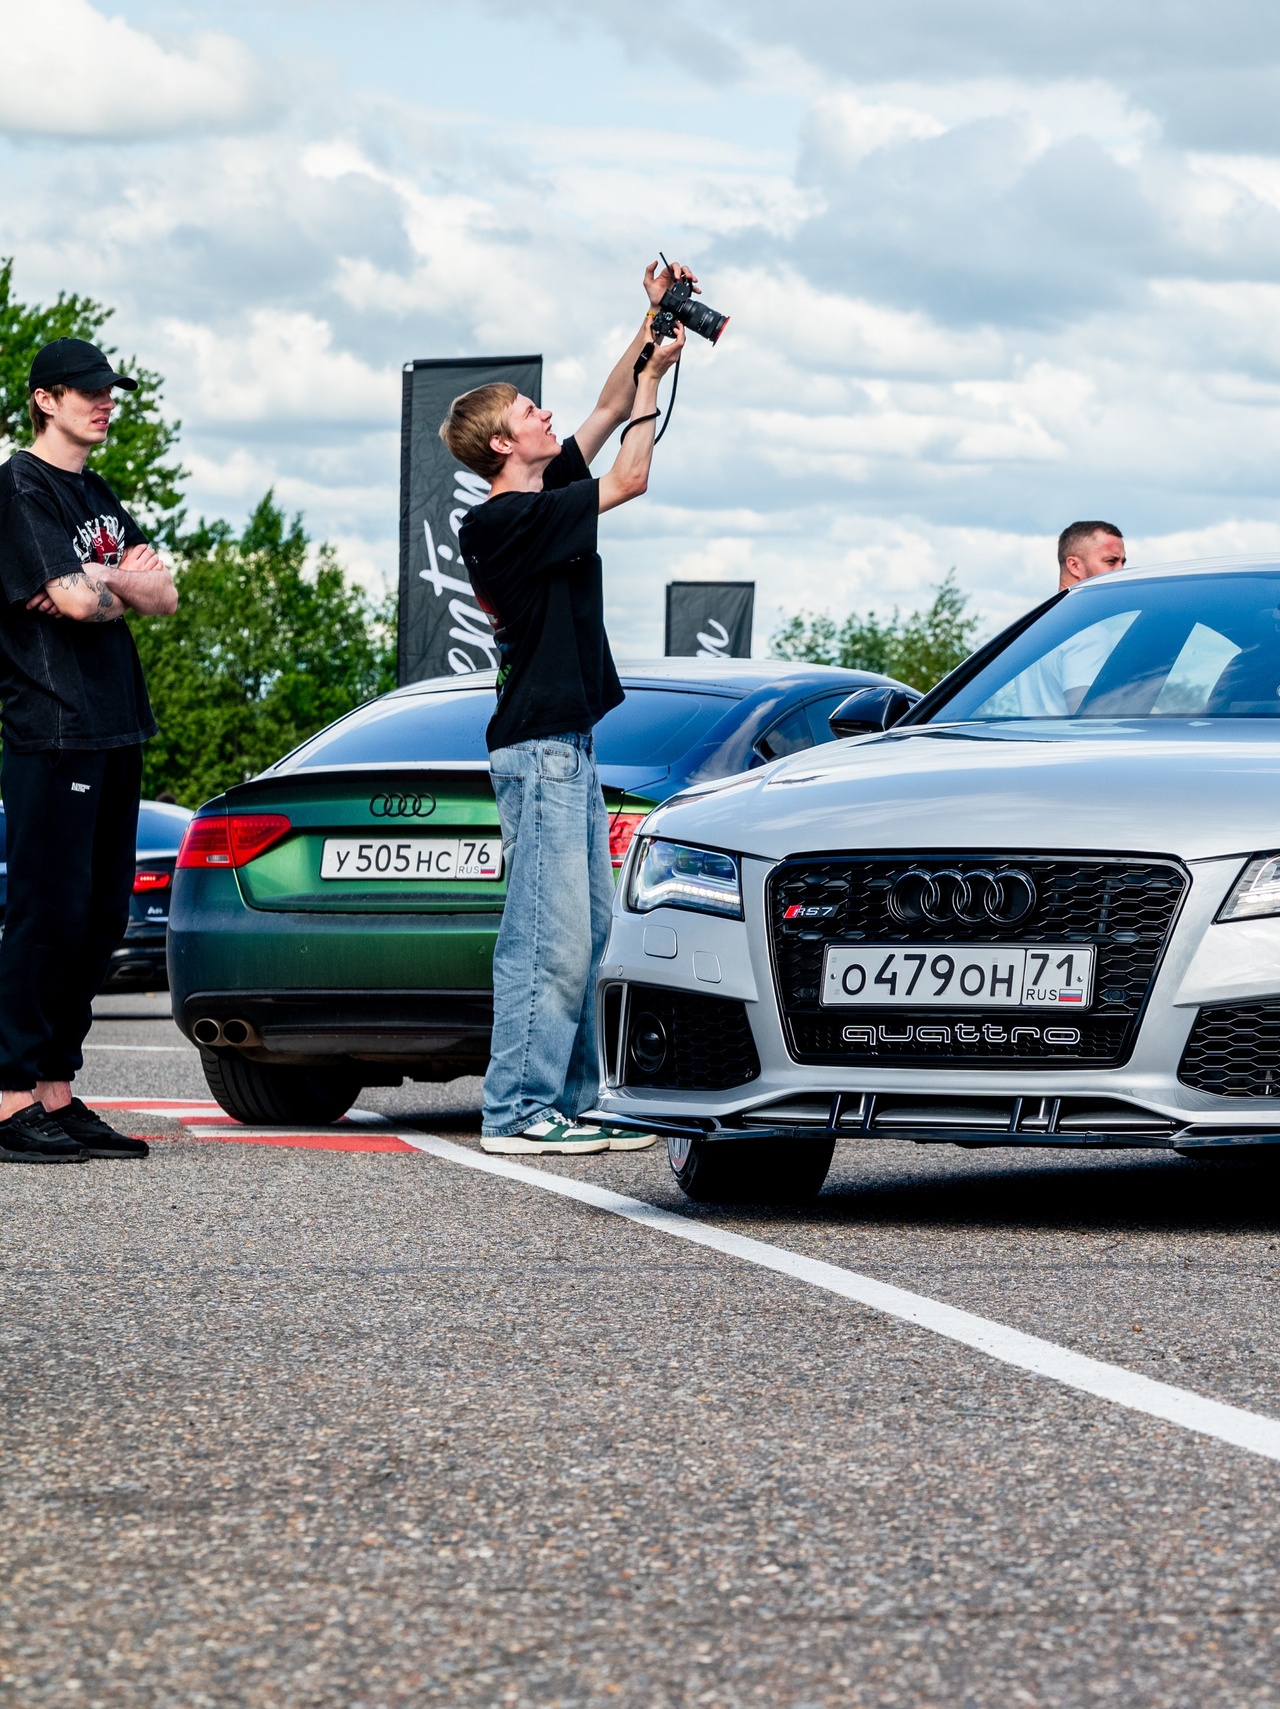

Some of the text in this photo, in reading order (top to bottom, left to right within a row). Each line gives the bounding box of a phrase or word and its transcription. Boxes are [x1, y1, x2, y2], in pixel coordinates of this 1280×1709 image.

[464, 843, 490, 864] 76
[458, 866, 479, 874] RUS
[1030, 953, 1074, 986] 71
[1025, 989, 1057, 1001] RUS
[843, 1024, 1080, 1045] quattro
